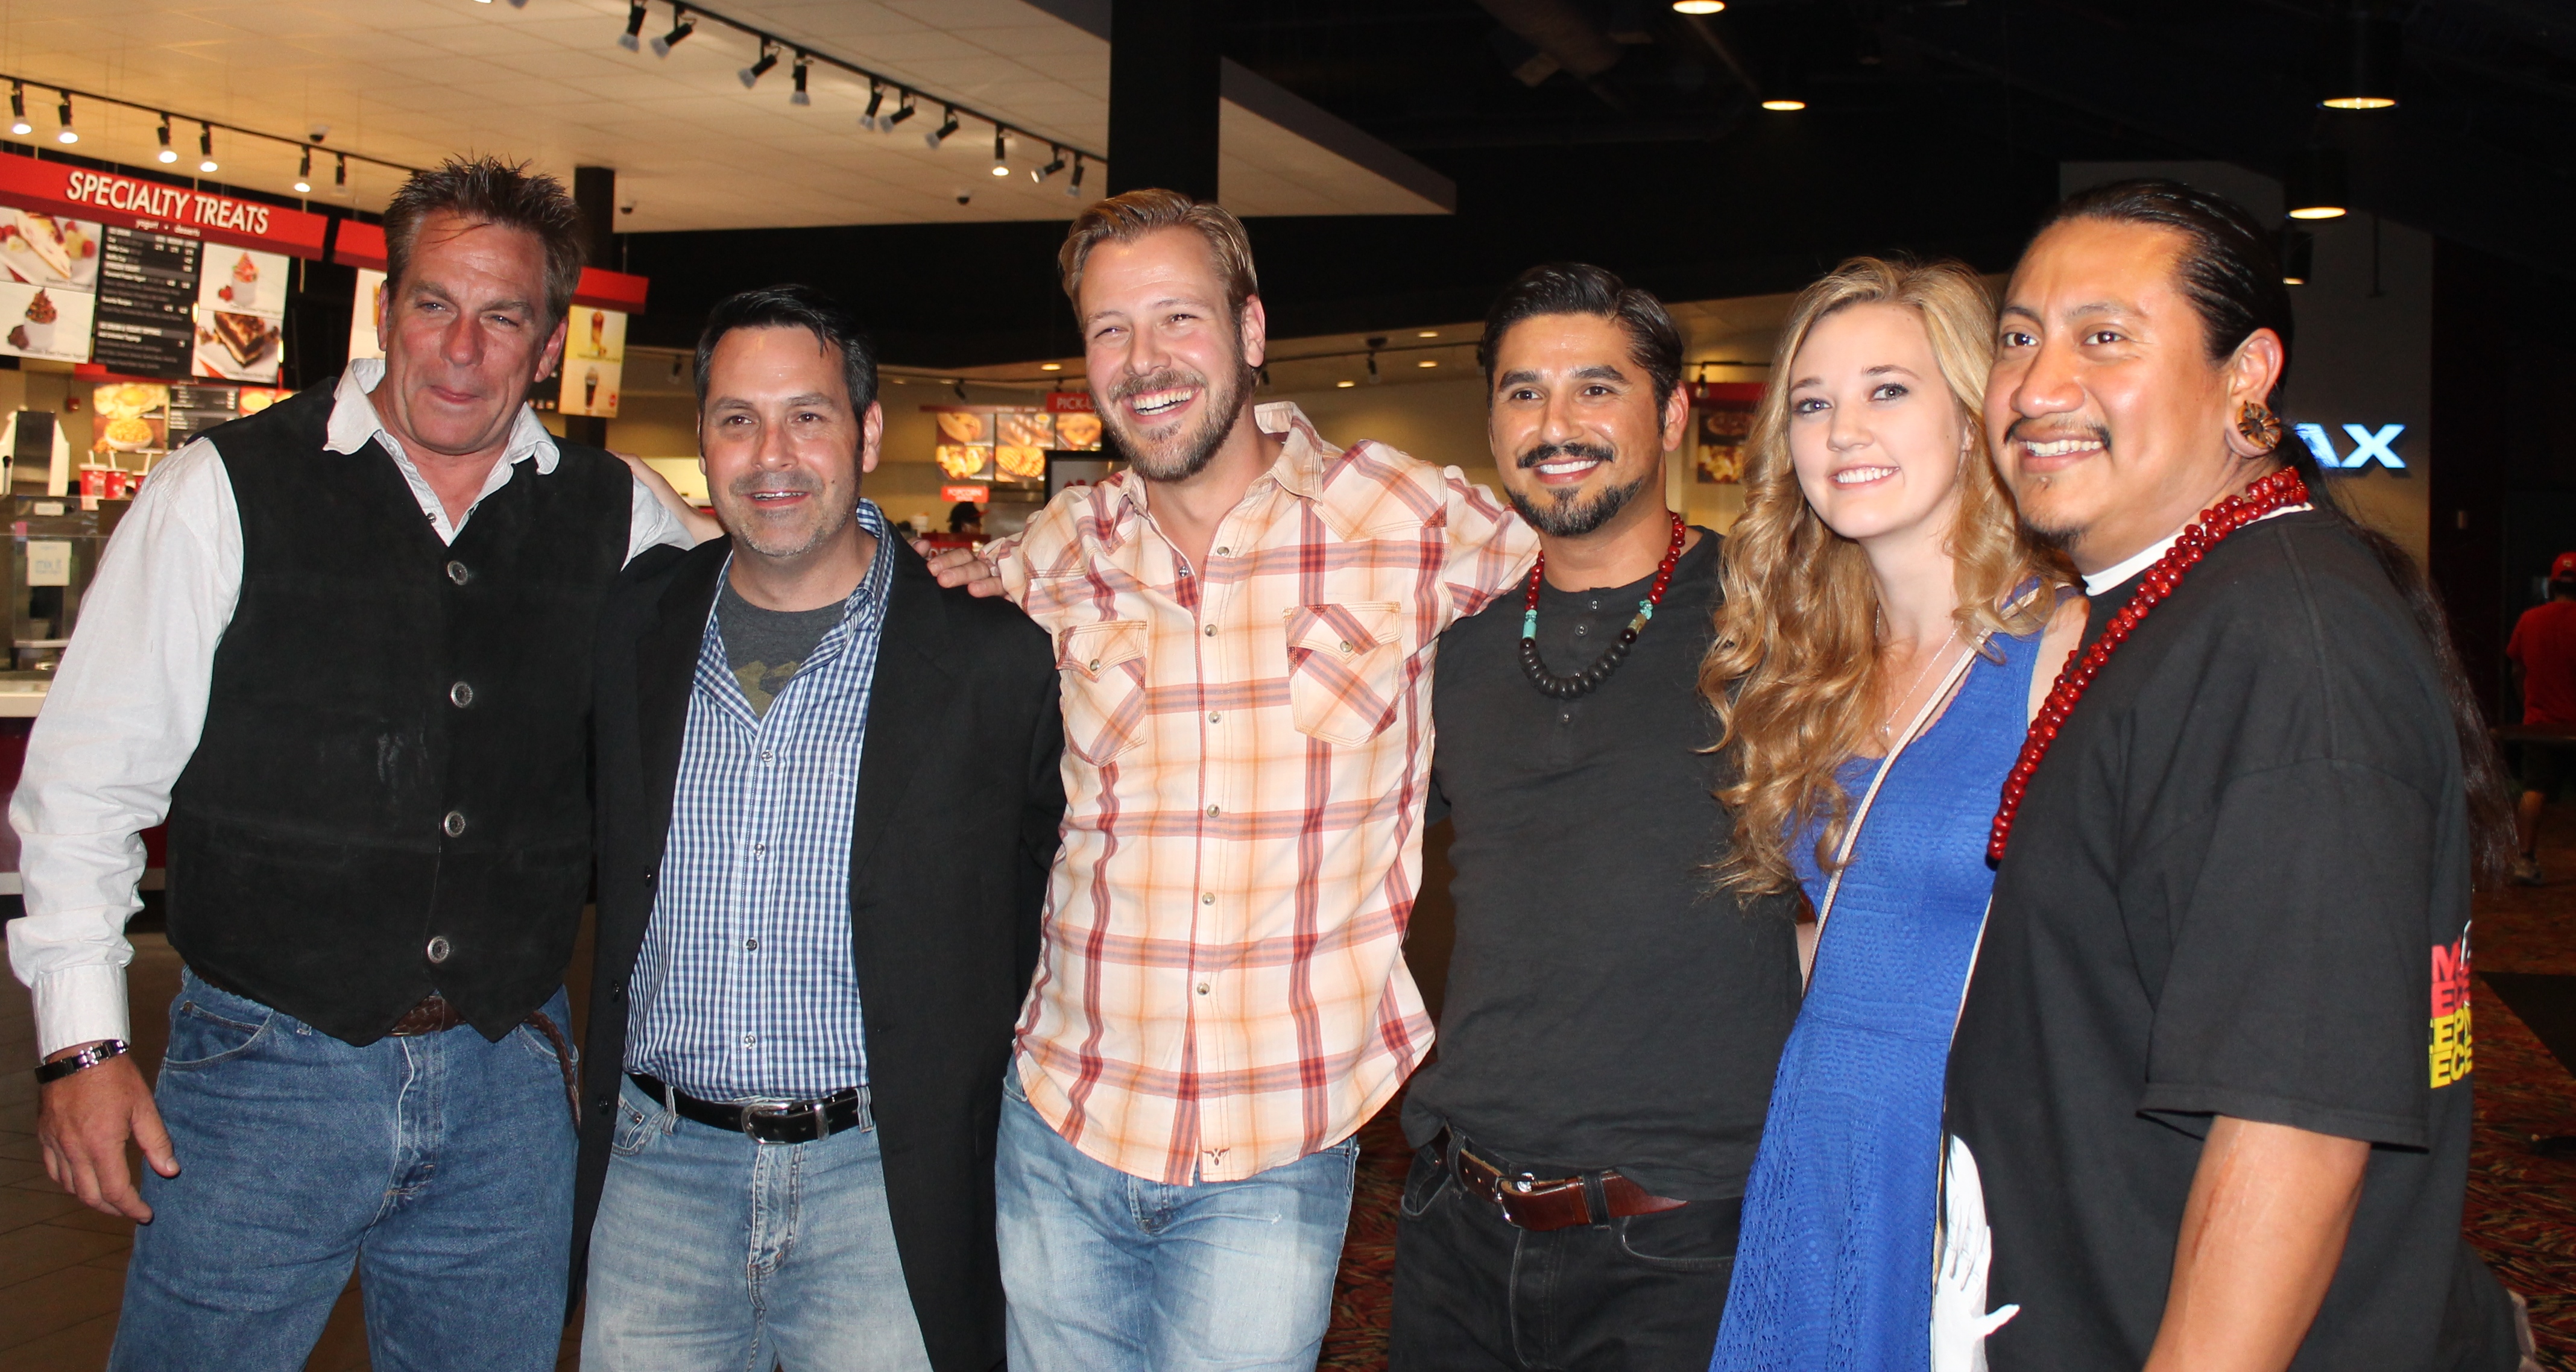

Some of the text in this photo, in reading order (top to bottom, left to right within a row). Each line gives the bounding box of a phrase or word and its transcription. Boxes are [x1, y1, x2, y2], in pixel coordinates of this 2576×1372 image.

[66, 171, 270, 235] SPECIALTY TREATS
[135, 219, 159, 230] yogurt
